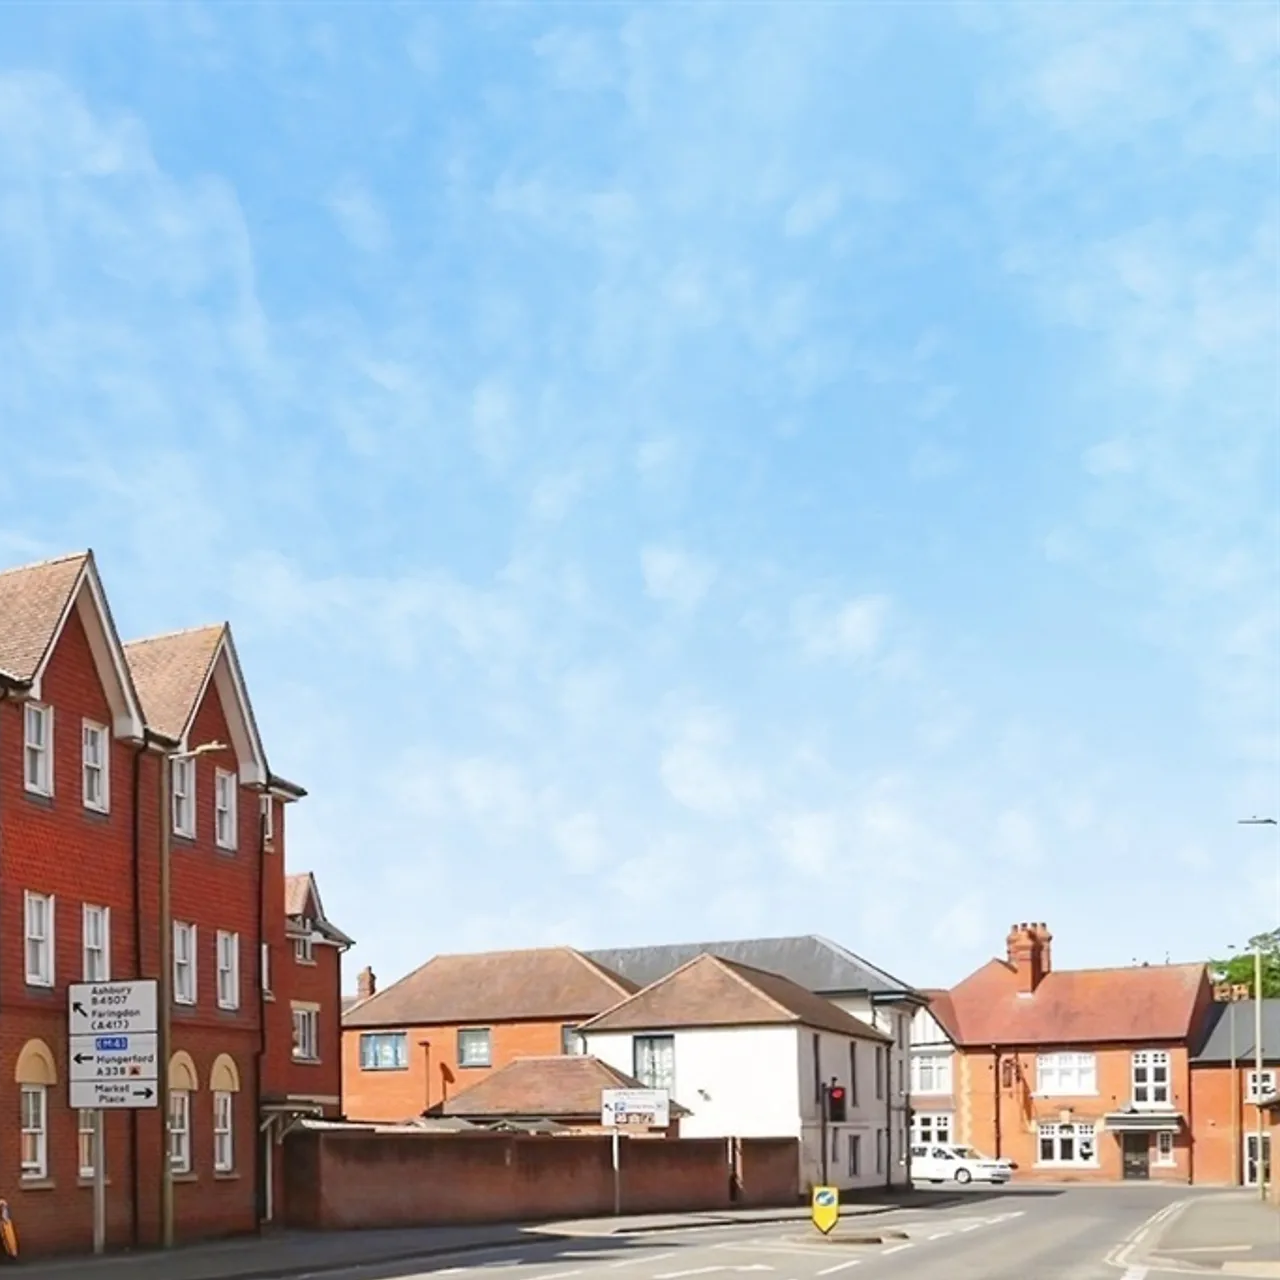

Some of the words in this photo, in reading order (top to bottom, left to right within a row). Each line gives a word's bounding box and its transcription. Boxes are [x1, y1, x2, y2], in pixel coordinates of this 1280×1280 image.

[91, 986, 132, 995] Ashbury
[91, 995, 128, 1005] B4507
[91, 1008, 140, 1019] Faringdon
[91, 1020, 129, 1030] (A417)
[97, 1054, 154, 1064] Hungerford
[97, 1066, 126, 1076] A338
[95, 1084, 130, 1093] Market
[99, 1095, 126, 1104] Place
